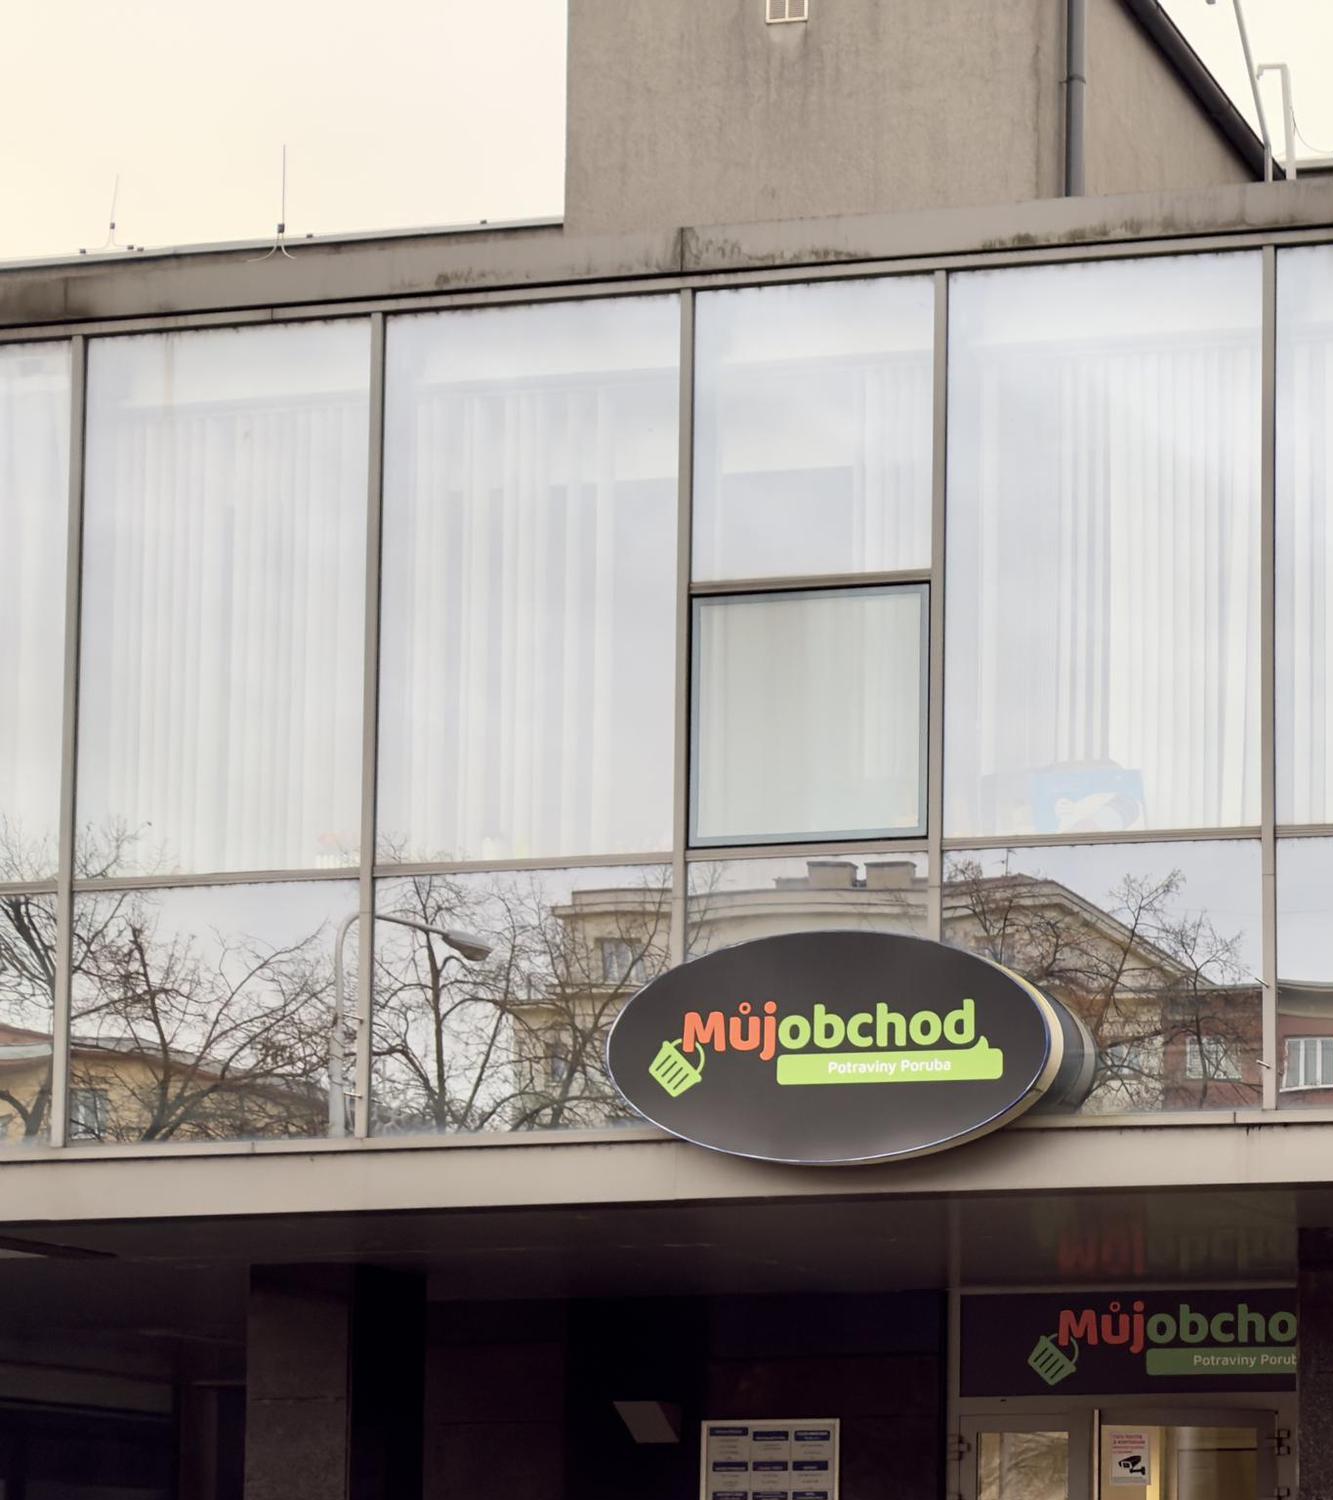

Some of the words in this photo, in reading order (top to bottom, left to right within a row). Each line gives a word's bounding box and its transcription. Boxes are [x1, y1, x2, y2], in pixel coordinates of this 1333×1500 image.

[828, 1059, 897, 1077] Potraviny
[901, 1057, 951, 1073] Poruba
[1193, 1354, 1257, 1368] Potraviny
